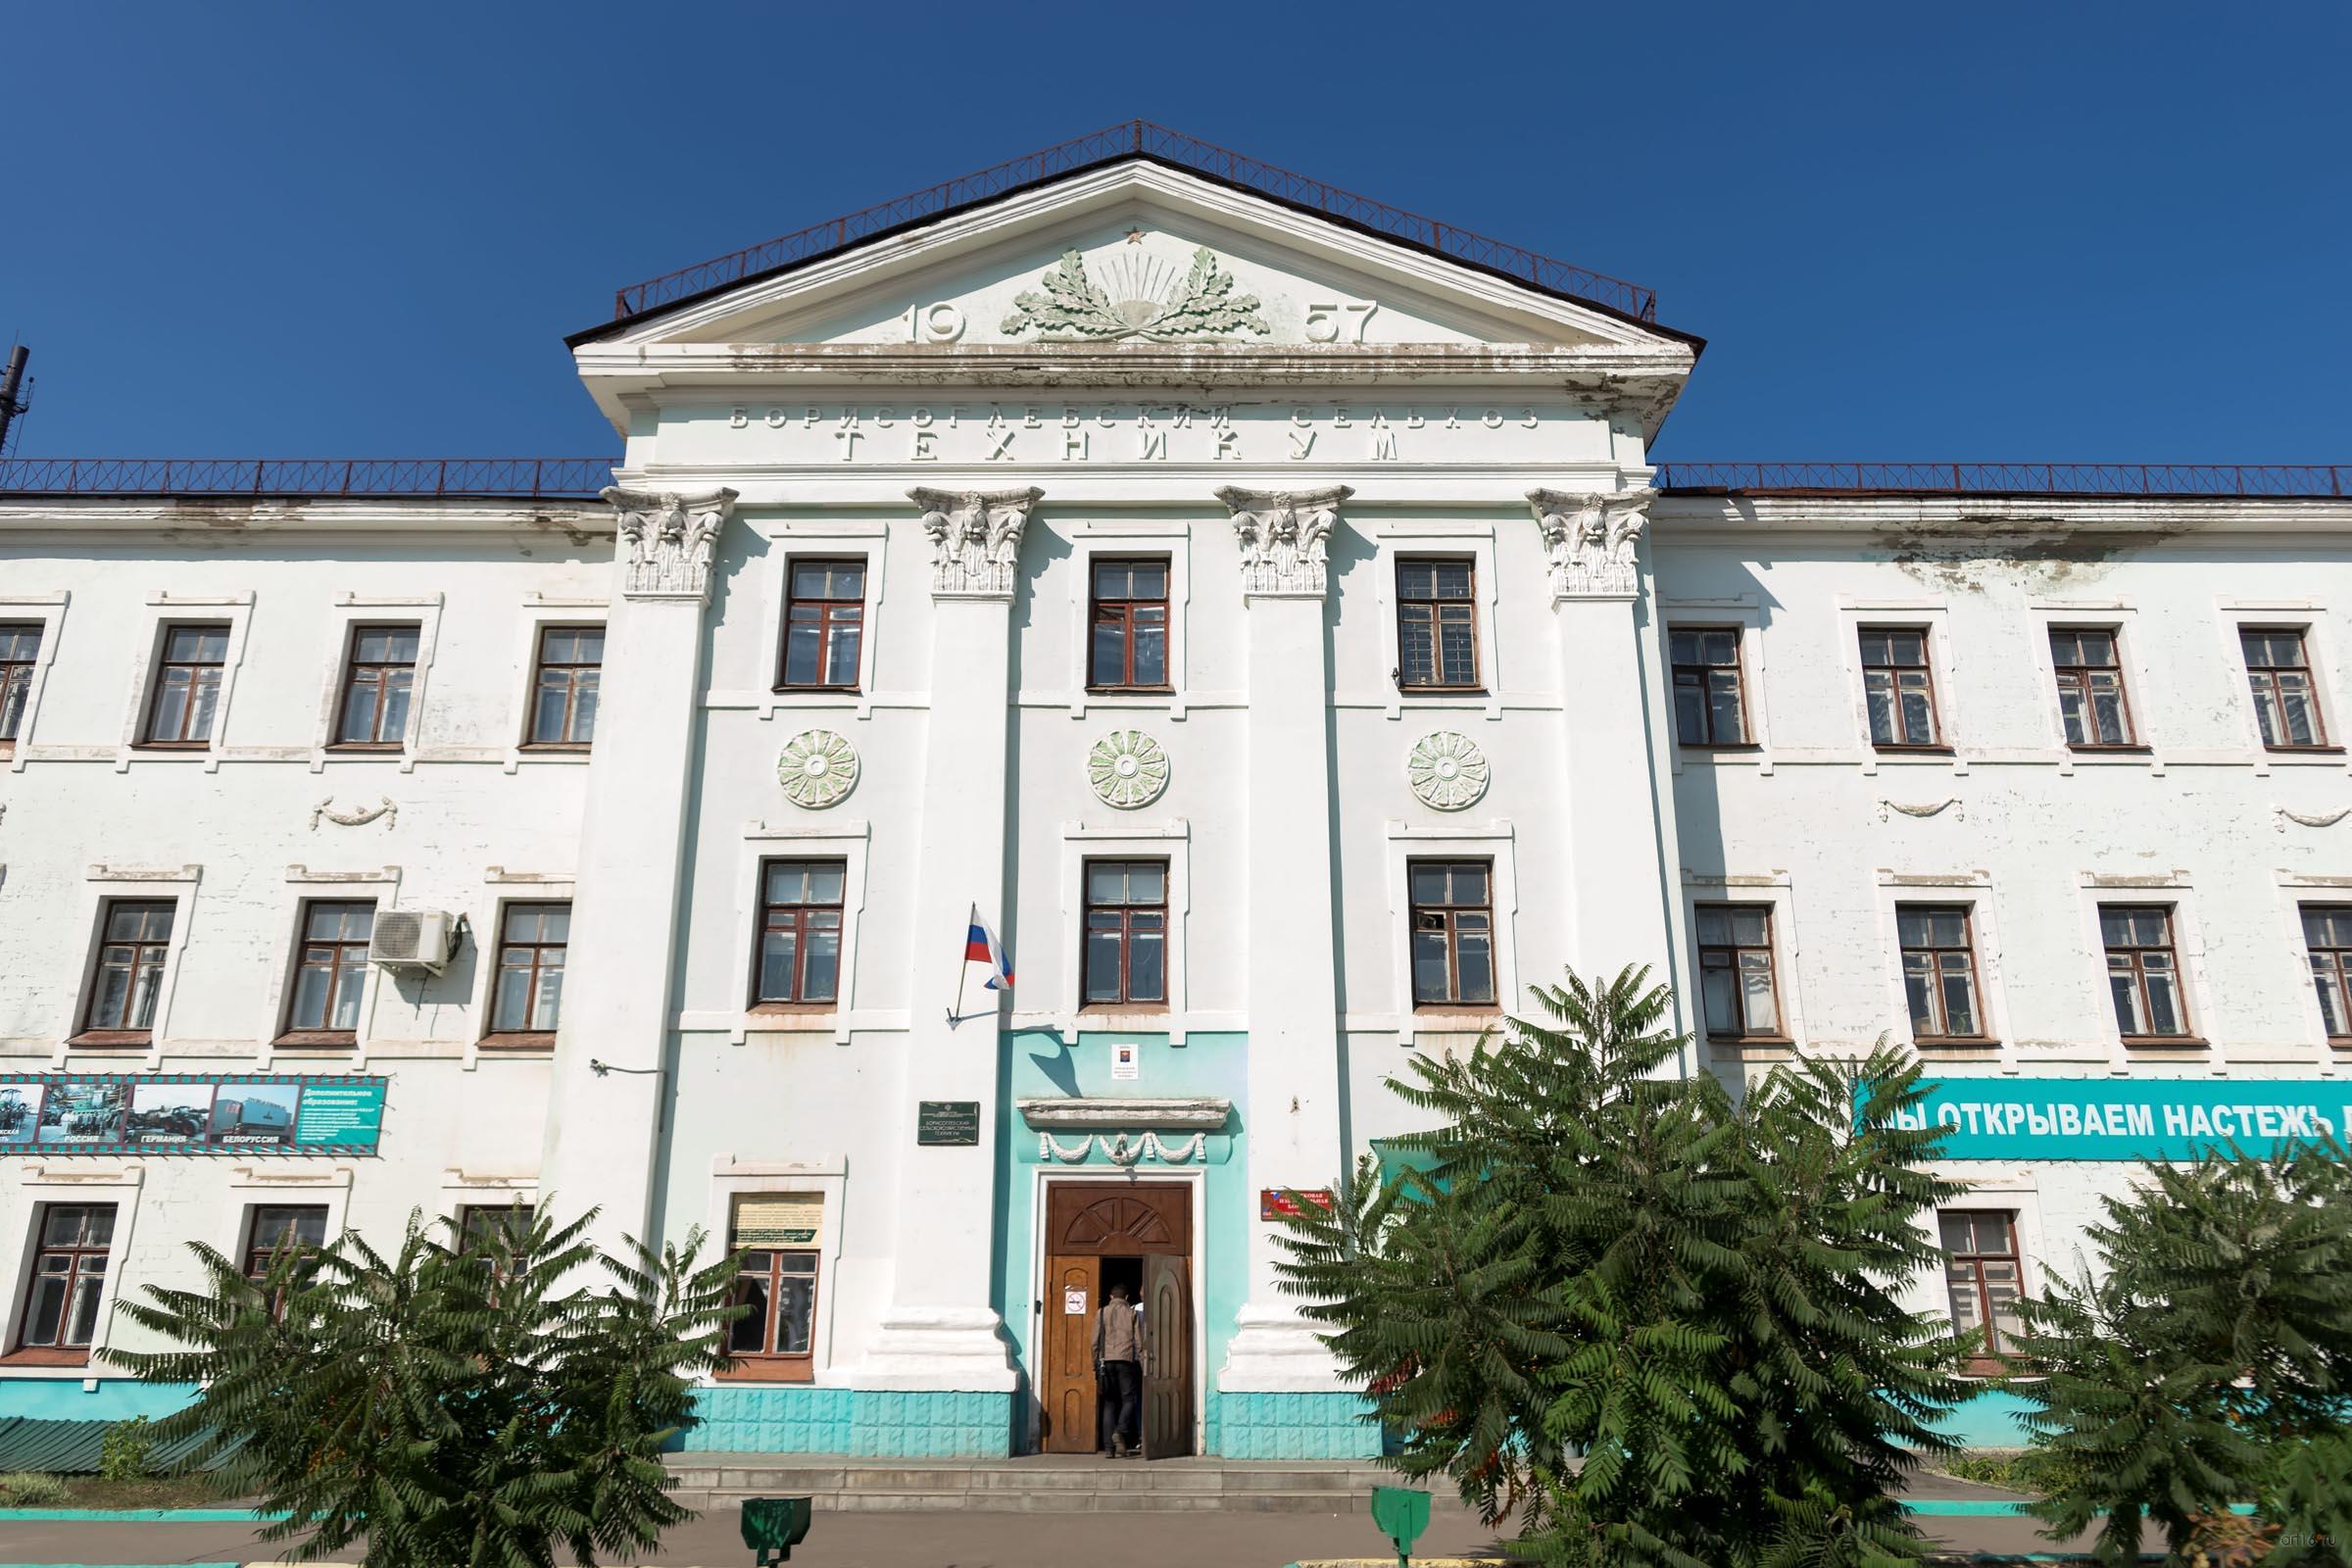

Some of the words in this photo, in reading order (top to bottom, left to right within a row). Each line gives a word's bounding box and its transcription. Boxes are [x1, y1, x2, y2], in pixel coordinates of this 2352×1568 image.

[902, 301, 966, 344] 19
[1304, 299, 1379, 346] 57
[1291, 407, 1539, 429] СЕЛЬХОЗ
[834, 430, 1397, 461] ТЕХНИКУМ
[1936, 1102, 2155, 1137] ОТКРЫВАЕМ
[2163, 1104, 2334, 1138] НАСТЕЖЬ
[140, 1135, 187, 1144] ГЕРМАНИЯ
[222, 1135, 279, 1144] БЕЛОРУССИЯ
